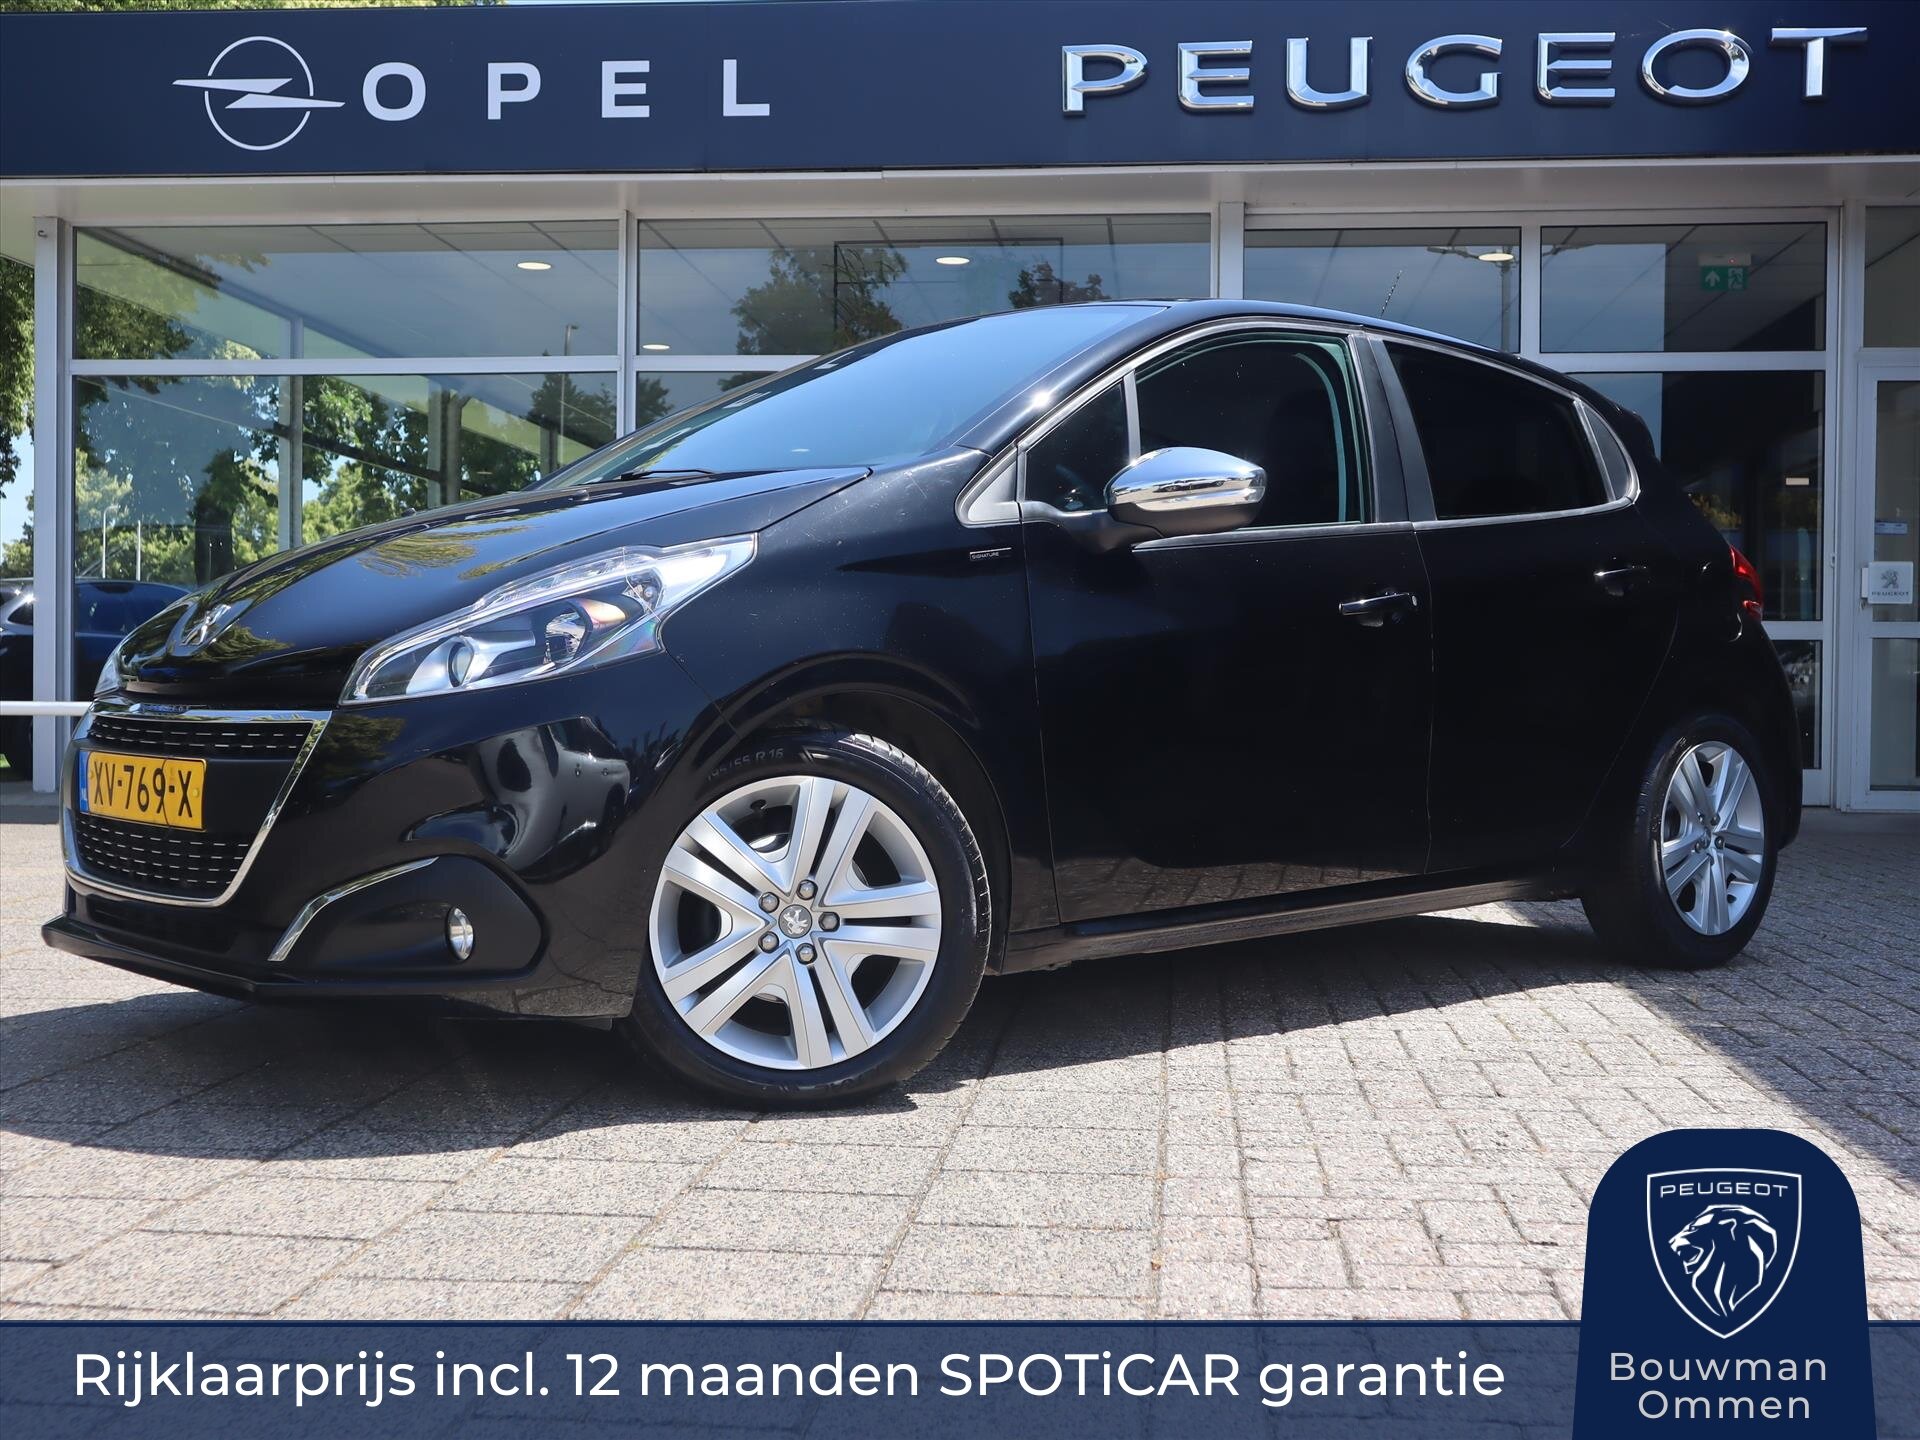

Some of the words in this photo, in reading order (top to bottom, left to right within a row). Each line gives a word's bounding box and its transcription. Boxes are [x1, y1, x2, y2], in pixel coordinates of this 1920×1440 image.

[362, 59, 770, 121] OPEL
[1062, 27, 1868, 116] PEUGEOT
[971, 551, 999, 560] SIGNATURE
[93, 760, 193, 818] XV-769-X
